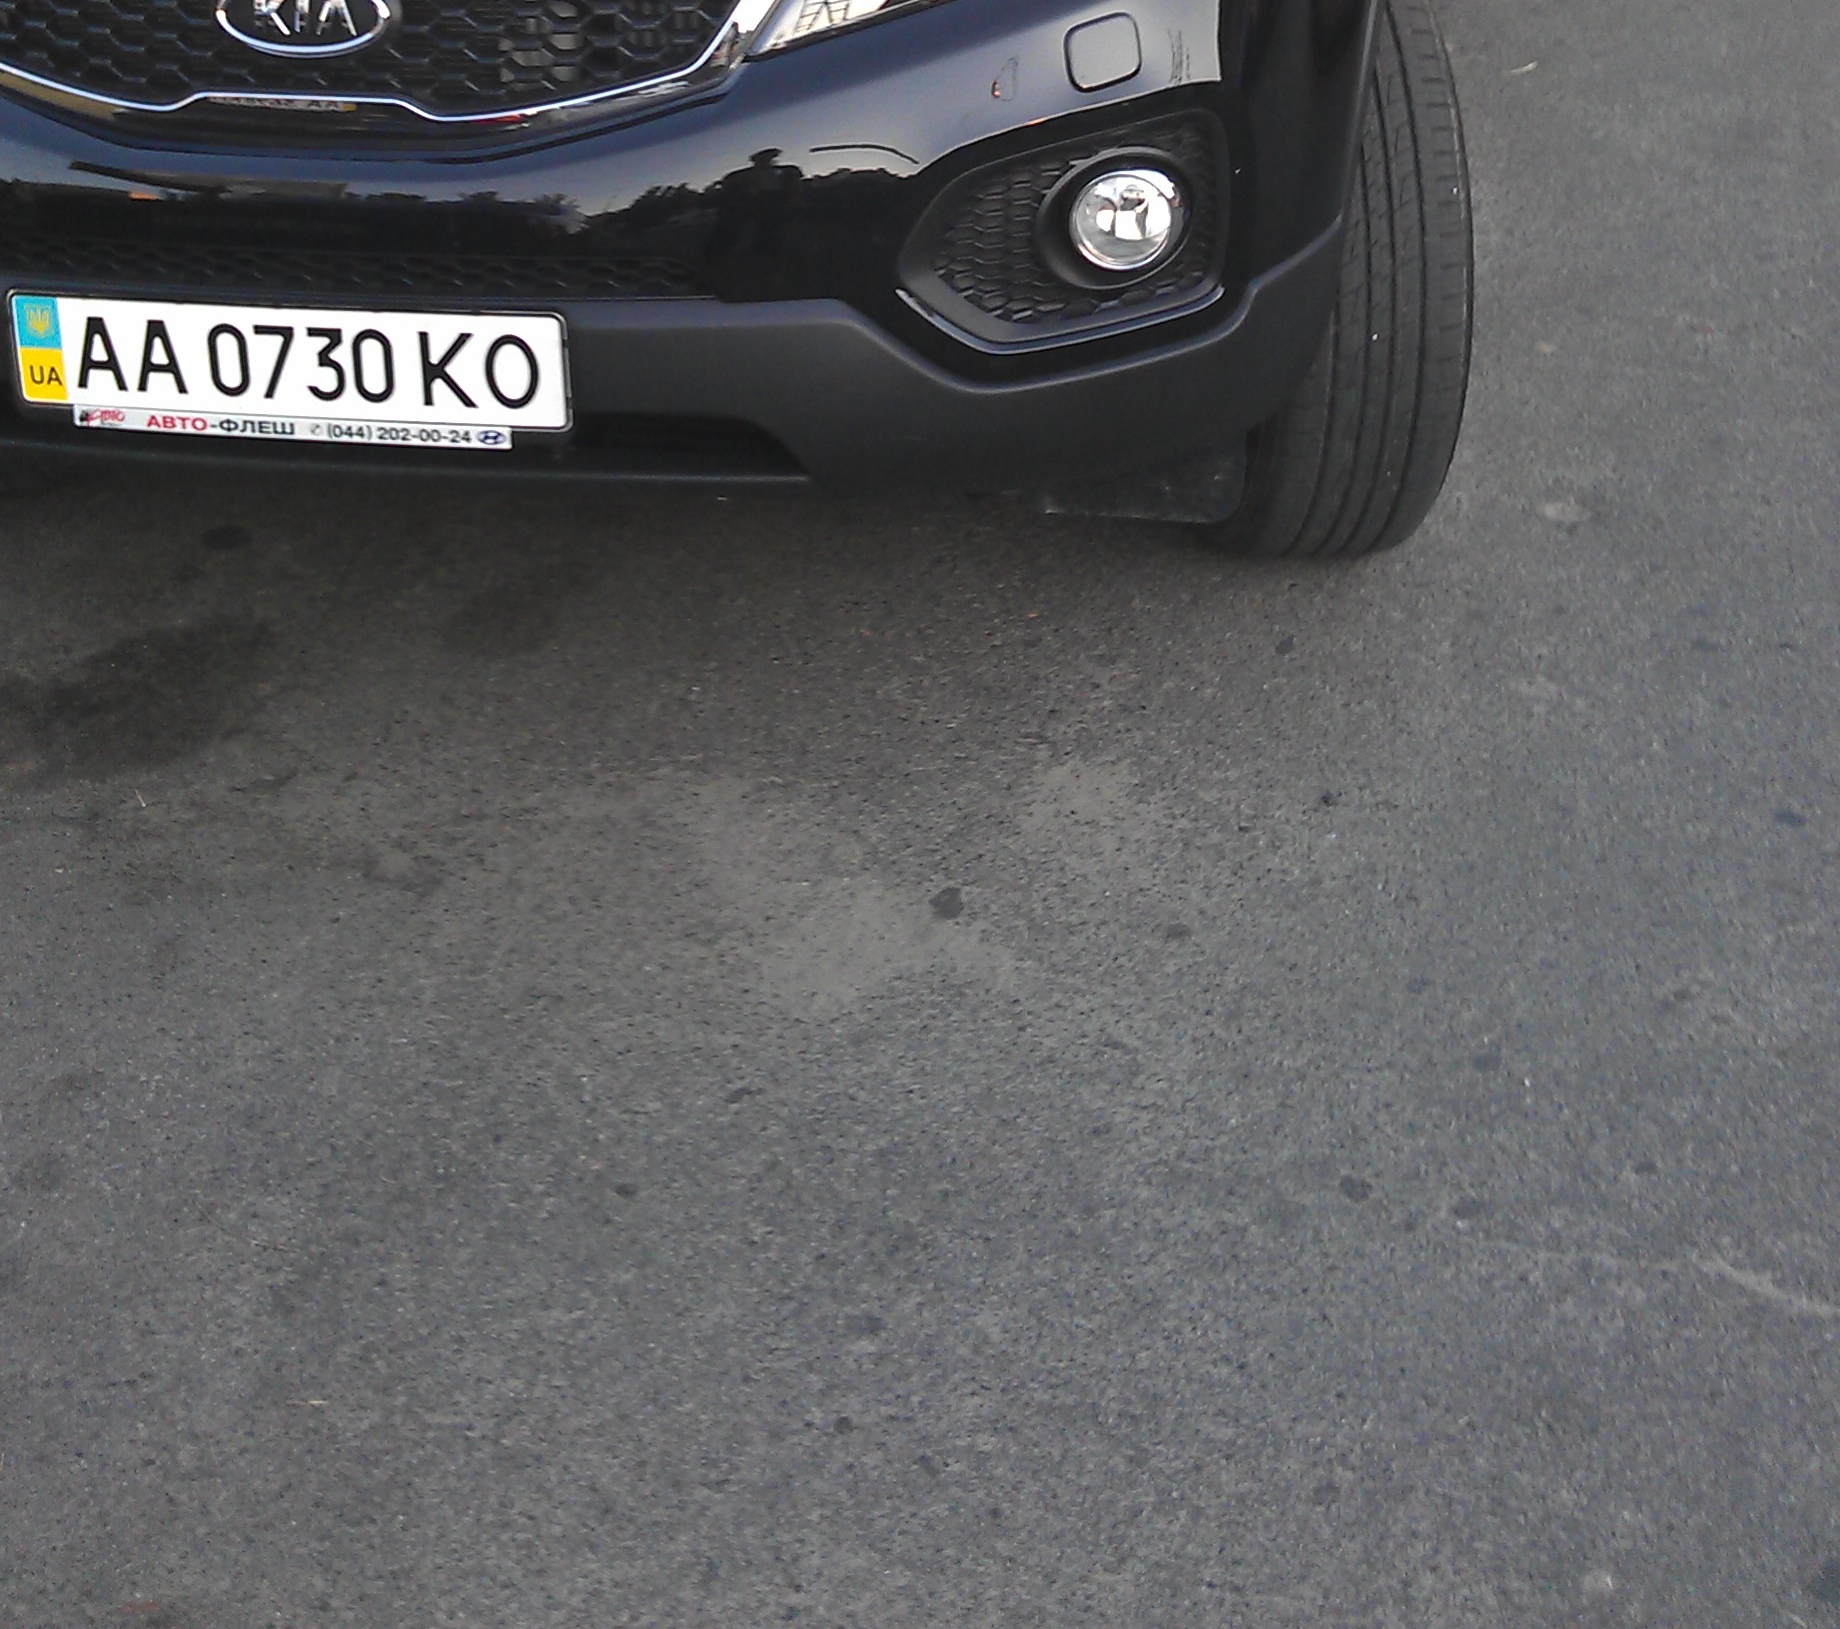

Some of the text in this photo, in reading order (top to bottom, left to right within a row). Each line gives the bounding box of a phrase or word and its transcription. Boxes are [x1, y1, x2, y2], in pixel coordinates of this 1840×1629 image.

[29, 364, 63, 386] UA
[77, 316, 540, 410] AA 0730 KO
[147, 415, 296, 435] АВТО-ФЛЕШ
[327, 424, 373, 441] (044)
[376, 426, 473, 444] 202-00-24
